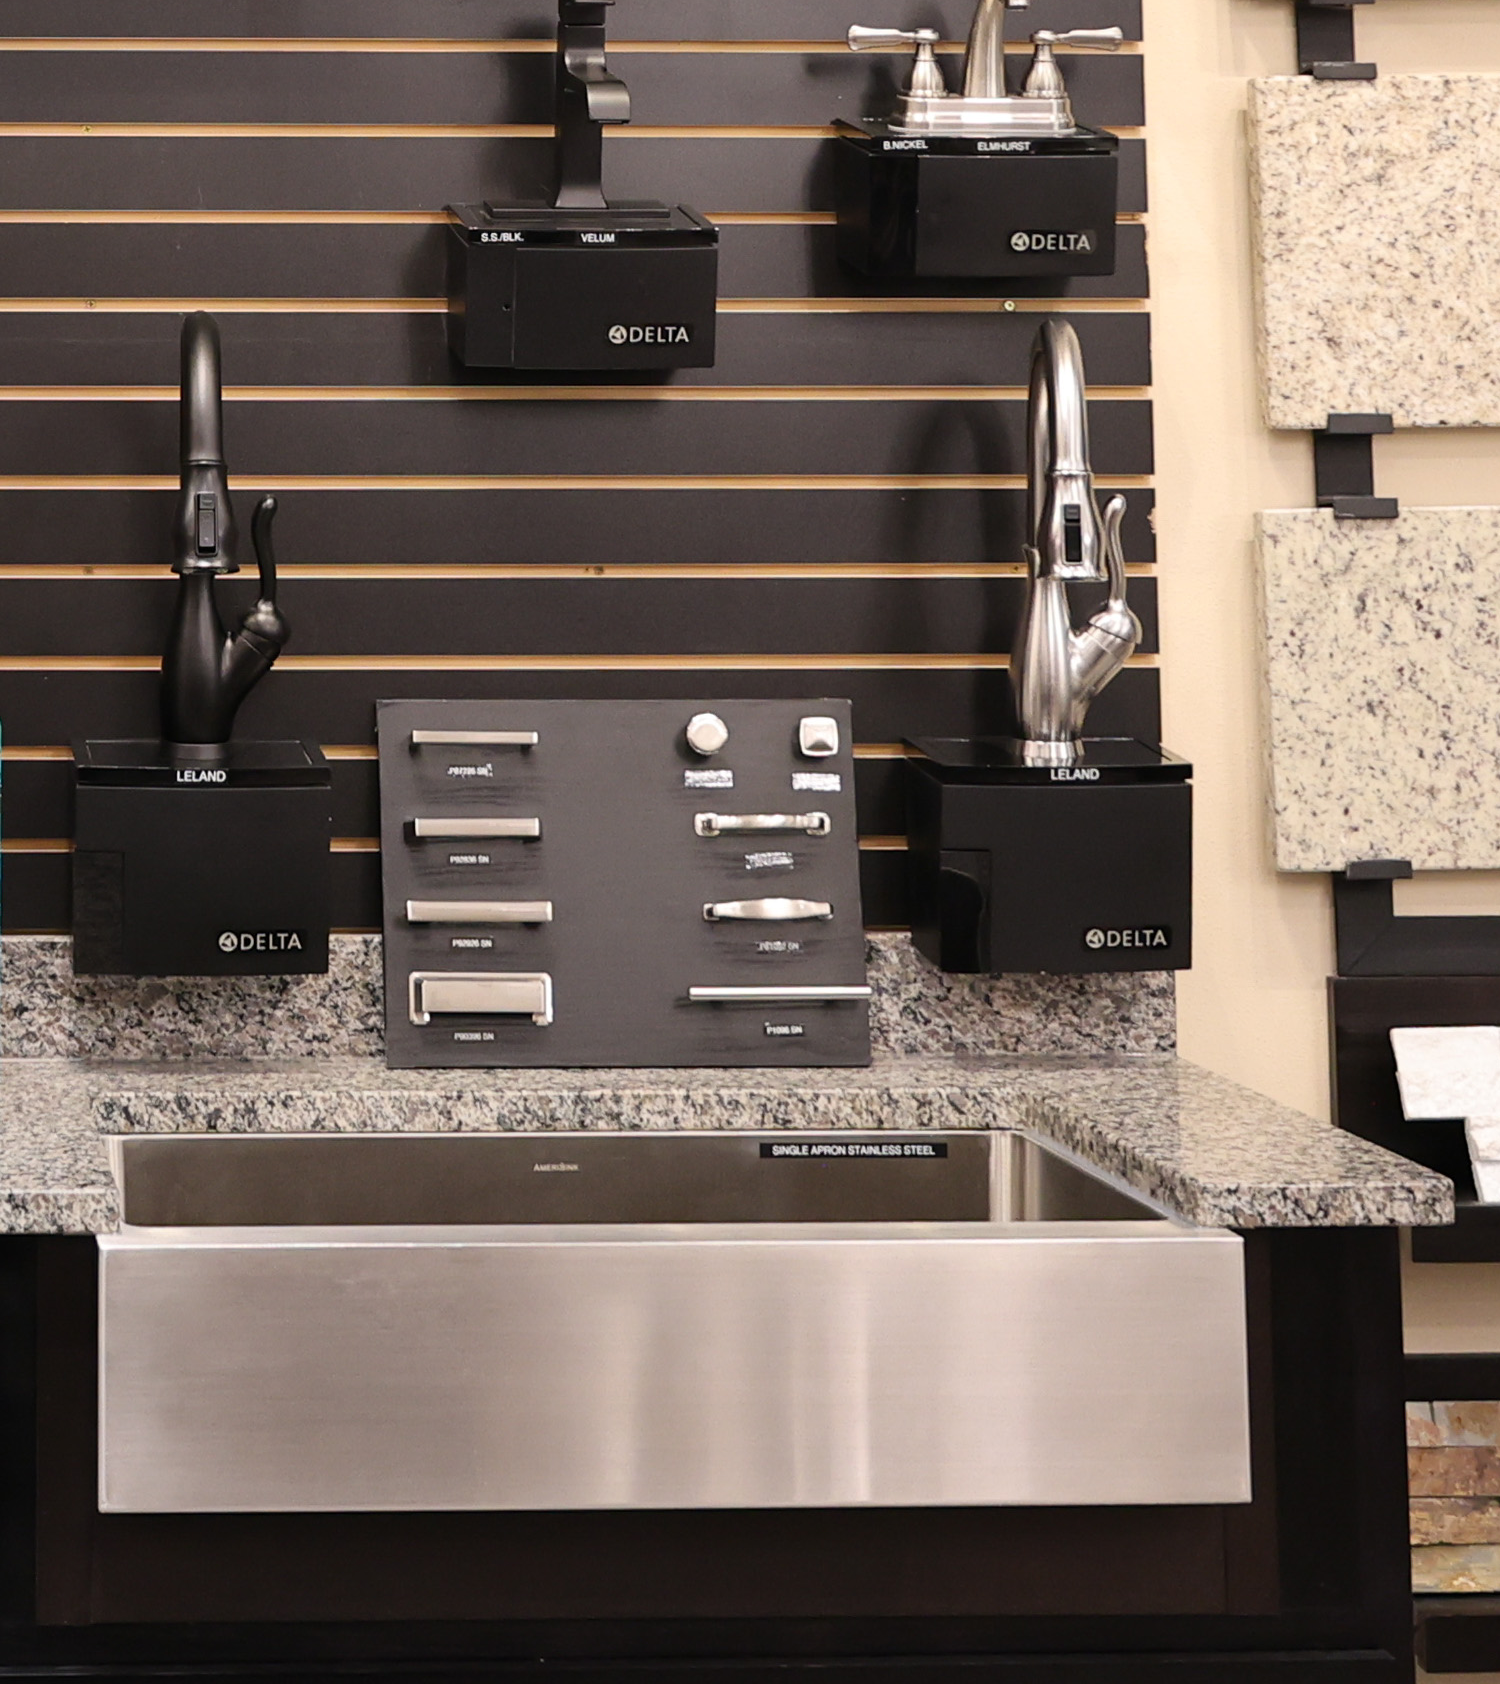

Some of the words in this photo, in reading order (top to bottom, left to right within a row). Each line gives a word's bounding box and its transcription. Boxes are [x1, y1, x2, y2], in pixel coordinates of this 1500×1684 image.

[977, 141, 1031, 152] ELMHURST
[580, 233, 615, 243] VELUM
[1031, 233, 1090, 251] DELTA
[629, 326, 690, 343] DELTA
[176, 770, 227, 783] LELAND
[1050, 768, 1101, 781] LELAND
[240, 932, 303, 950] DELTA
[1106, 929, 1167, 947] DELTA
[772, 1144, 809, 1156] SINGLE
[810, 1144, 847, 1156] APRON
[847, 1144, 903, 1156] STAINLESS
[903, 1144, 936, 1156] STEEL
